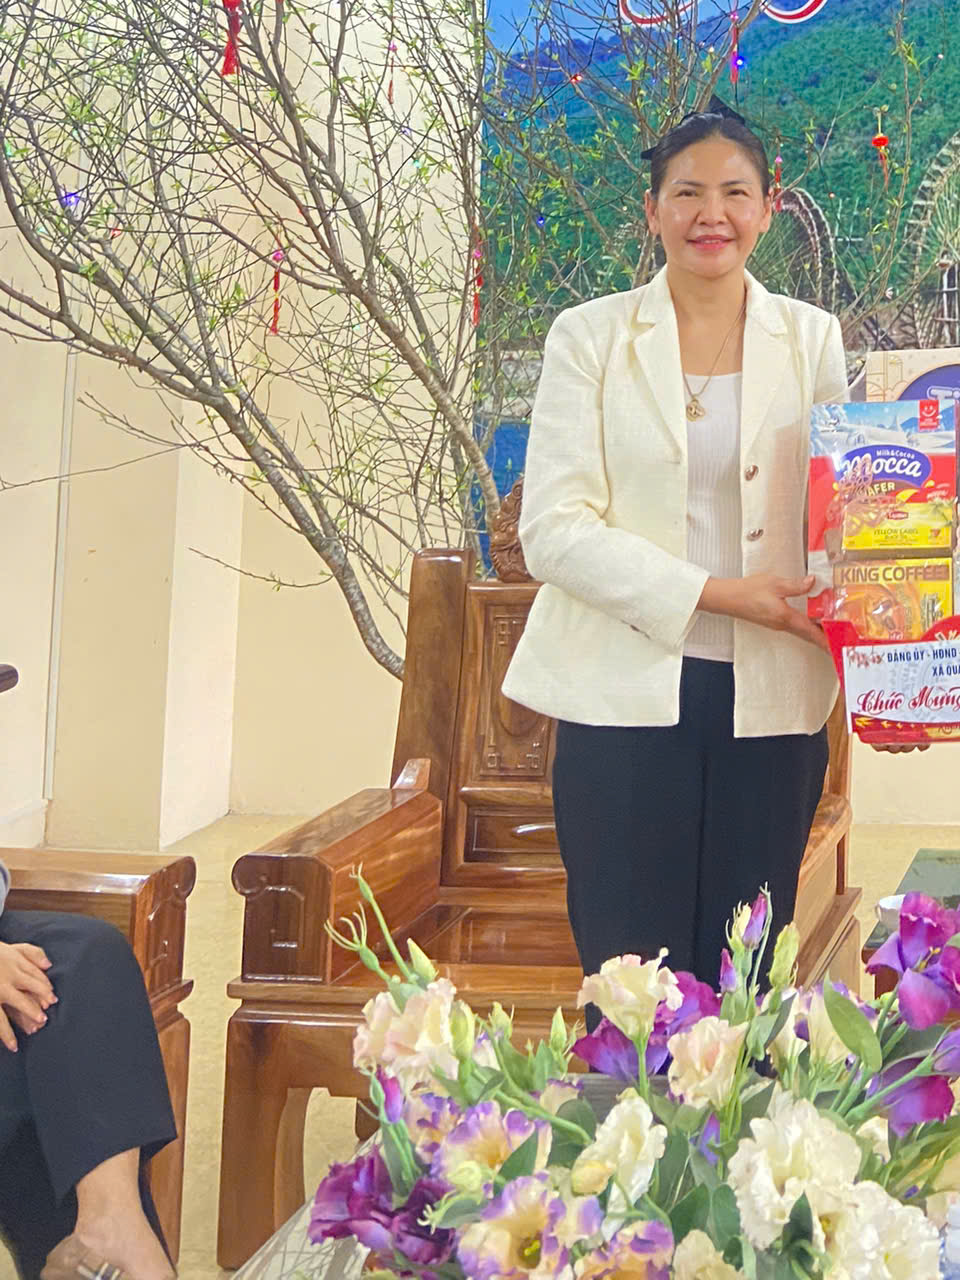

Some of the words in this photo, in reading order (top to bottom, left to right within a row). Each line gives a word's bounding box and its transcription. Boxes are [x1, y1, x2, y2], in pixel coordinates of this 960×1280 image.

[858, 481, 896, 497] AFER
[840, 567, 880, 583] KING
[881, 564, 950, 582] COFFEE
[857, 689, 905, 716] Chúc
